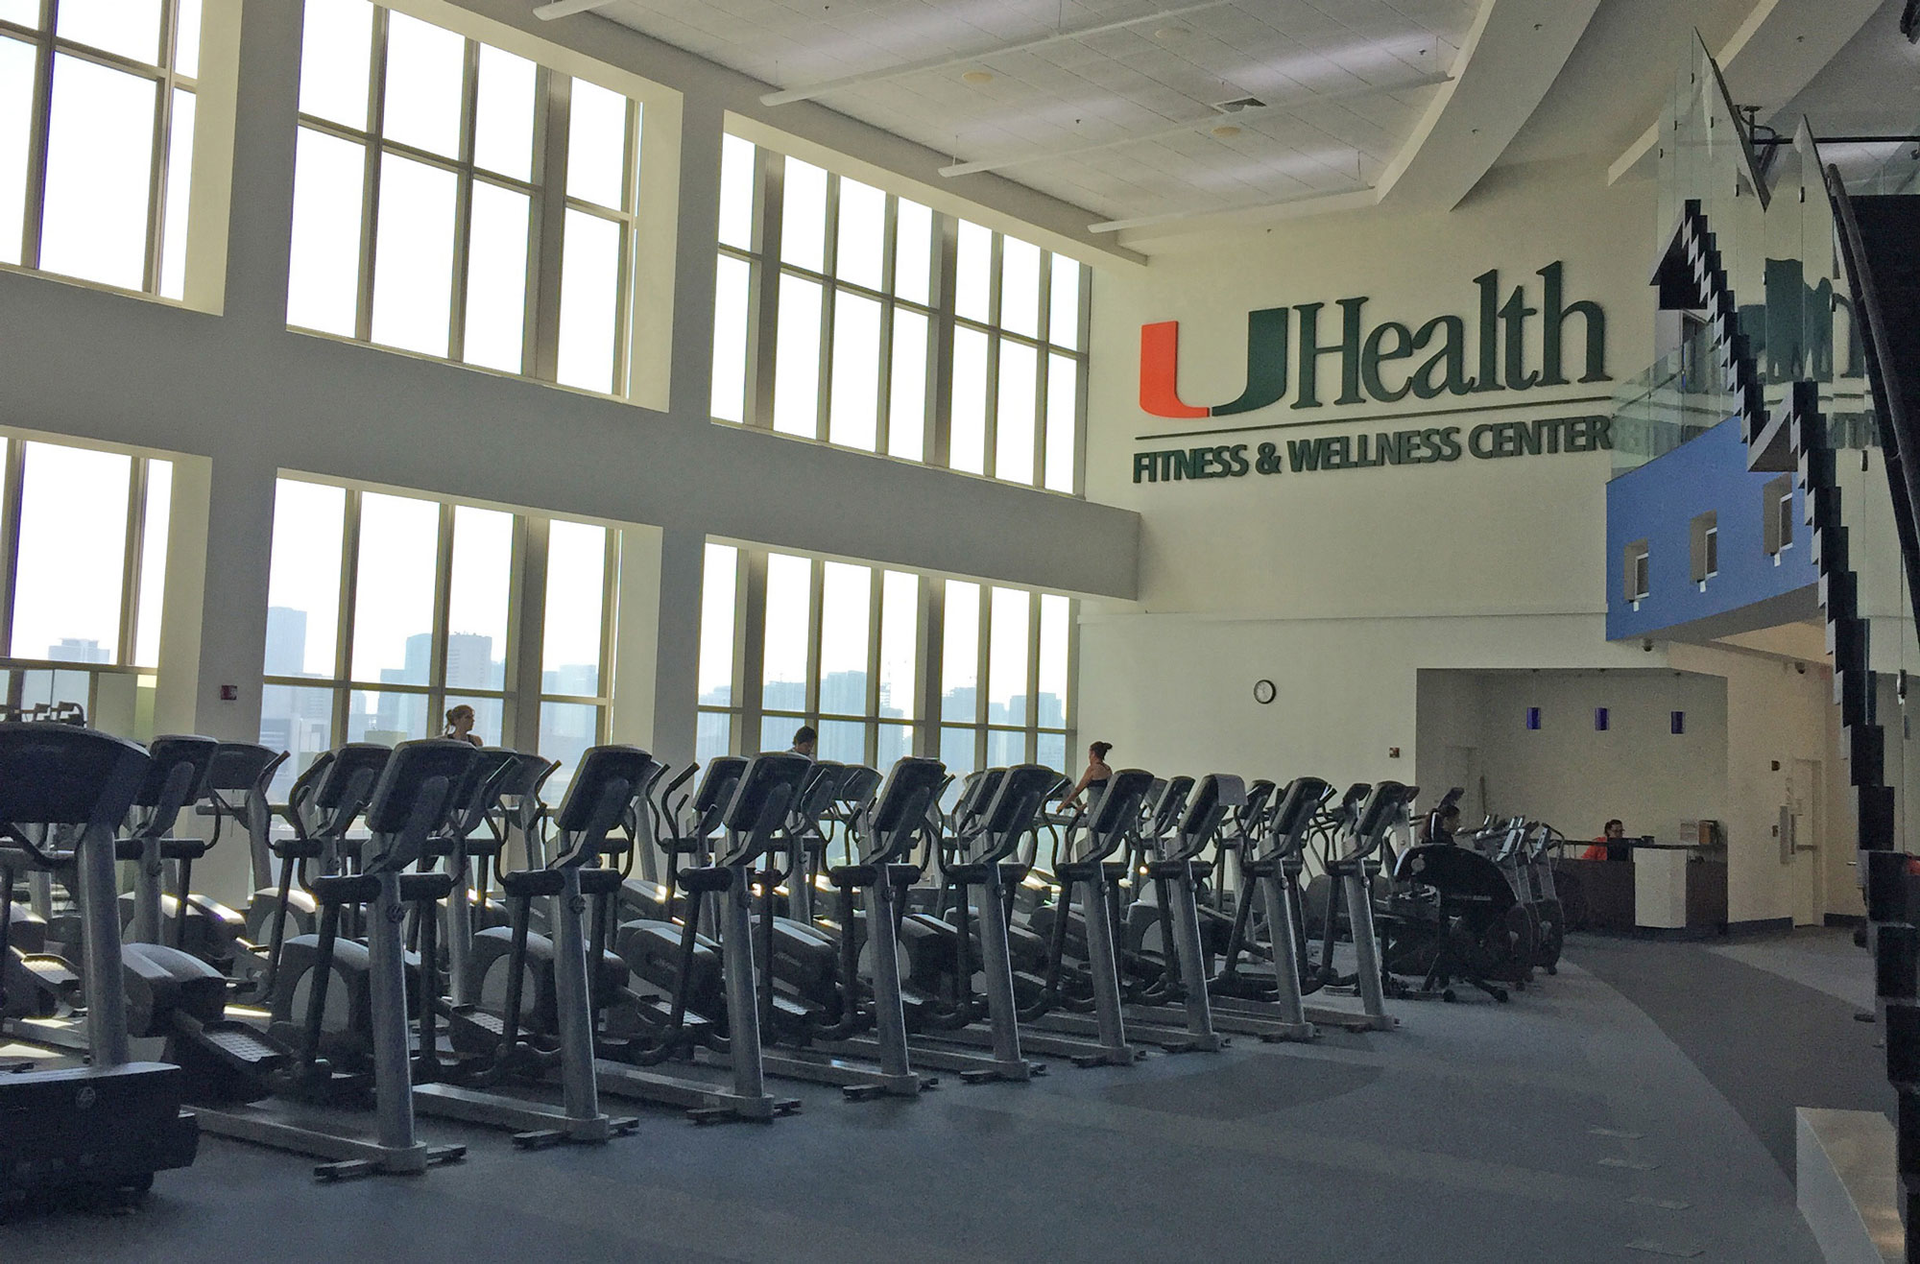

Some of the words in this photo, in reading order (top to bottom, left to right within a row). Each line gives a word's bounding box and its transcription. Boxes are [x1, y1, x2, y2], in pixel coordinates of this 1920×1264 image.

[1133, 444, 1249, 484] FITNESS
[1255, 442, 1283, 475] &
[1287, 427, 1462, 472] WELLNESS
[1468, 415, 1614, 460] CENTER
